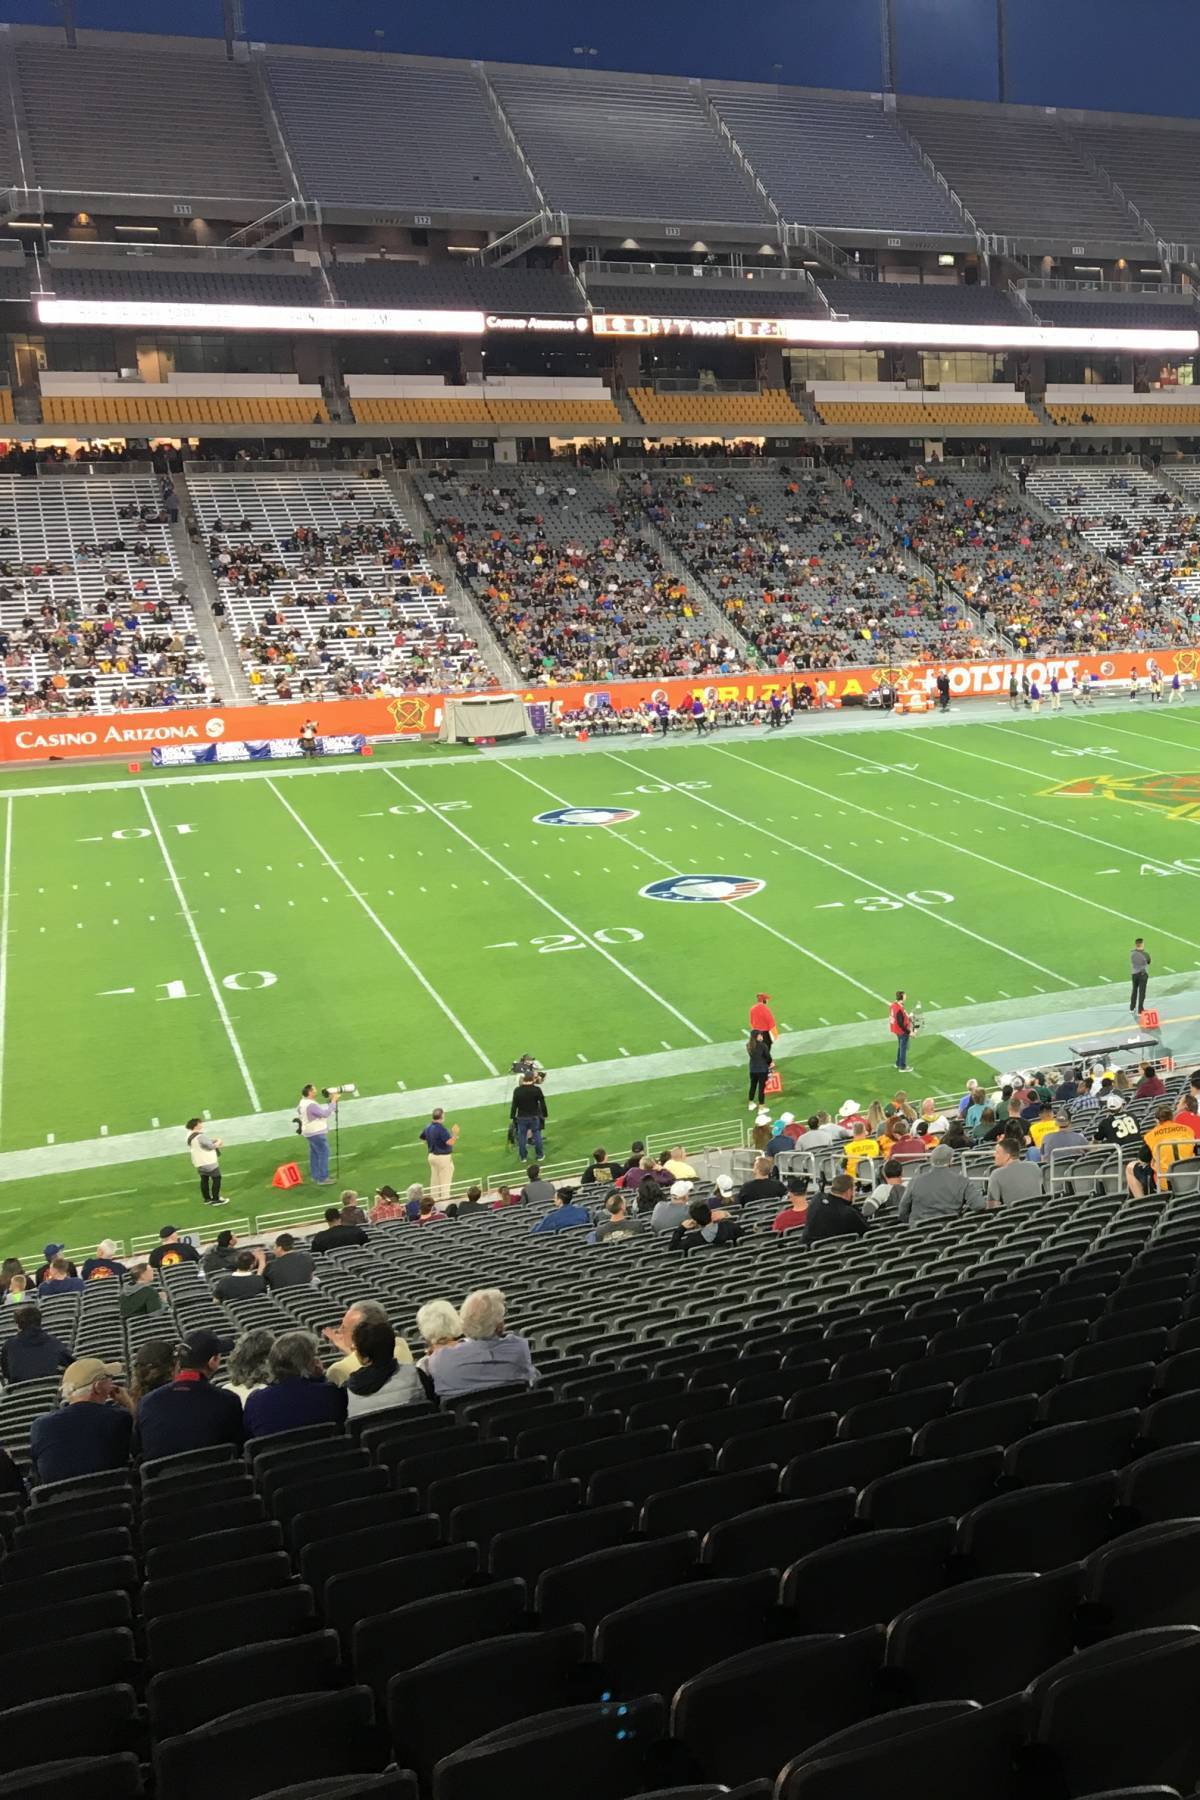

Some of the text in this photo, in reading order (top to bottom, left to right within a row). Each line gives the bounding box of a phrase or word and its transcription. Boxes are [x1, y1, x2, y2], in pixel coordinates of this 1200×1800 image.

[15, 725, 198, 749] CASINO ARIZONA
[853, 889, 956, 912] 30
[528, 927, 646, 954] 20
[154, 970, 279, 1002] 10
[1144, 1012, 1157, 1025] 30
